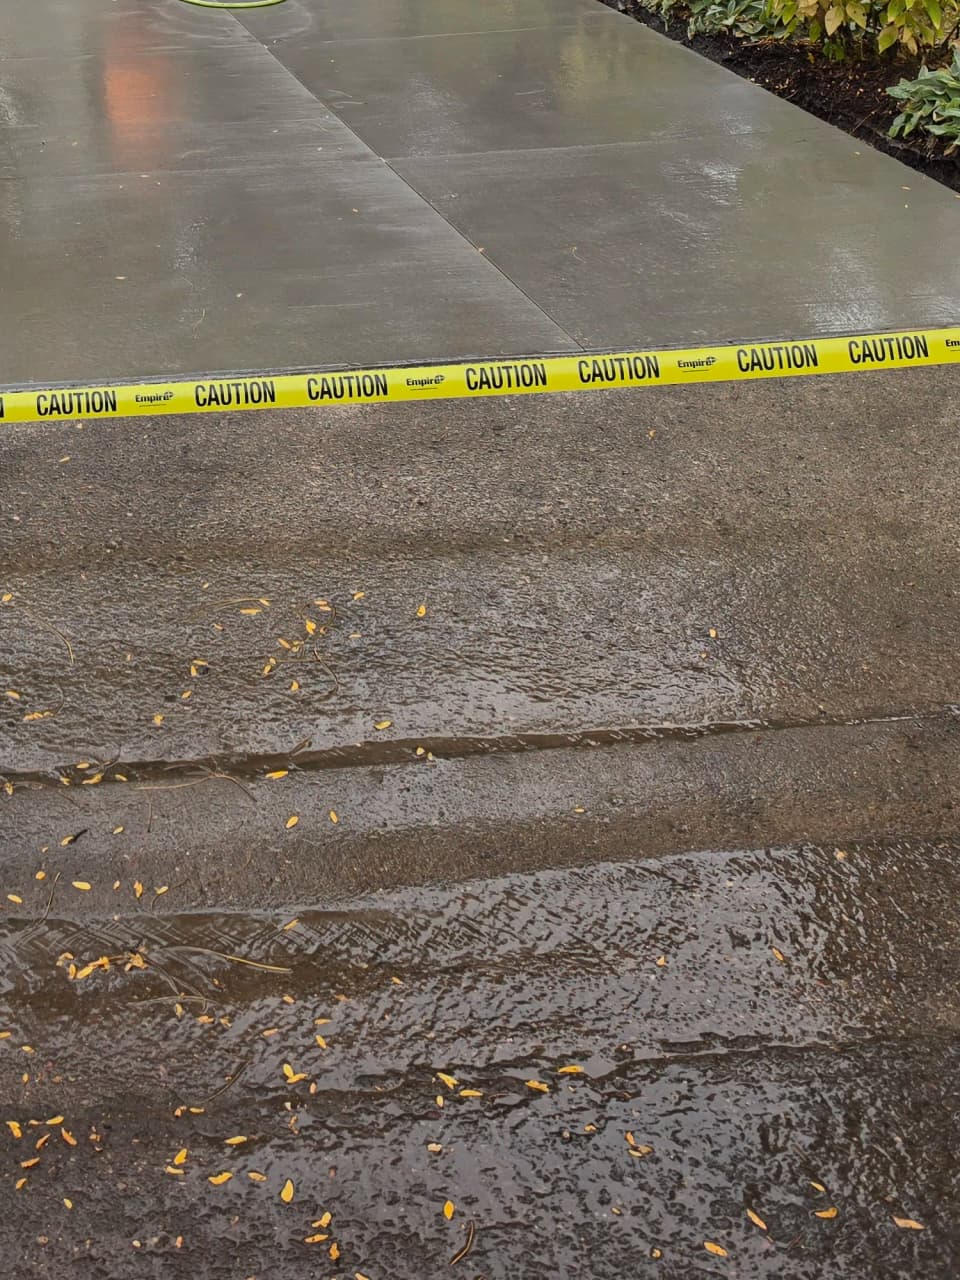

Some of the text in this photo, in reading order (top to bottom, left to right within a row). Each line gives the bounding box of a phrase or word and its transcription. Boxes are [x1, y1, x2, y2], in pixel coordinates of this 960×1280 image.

[36, 390, 117, 416] CAUTION
[195, 381, 276, 407] CAUTION
[307, 374, 388, 400] CAUTION
[465, 363, 547, 390] CAUTION
[577, 356, 660, 383] CAUTION
[737, 344, 818, 372] CAUTION
[848, 335, 928, 364] CAUTION
